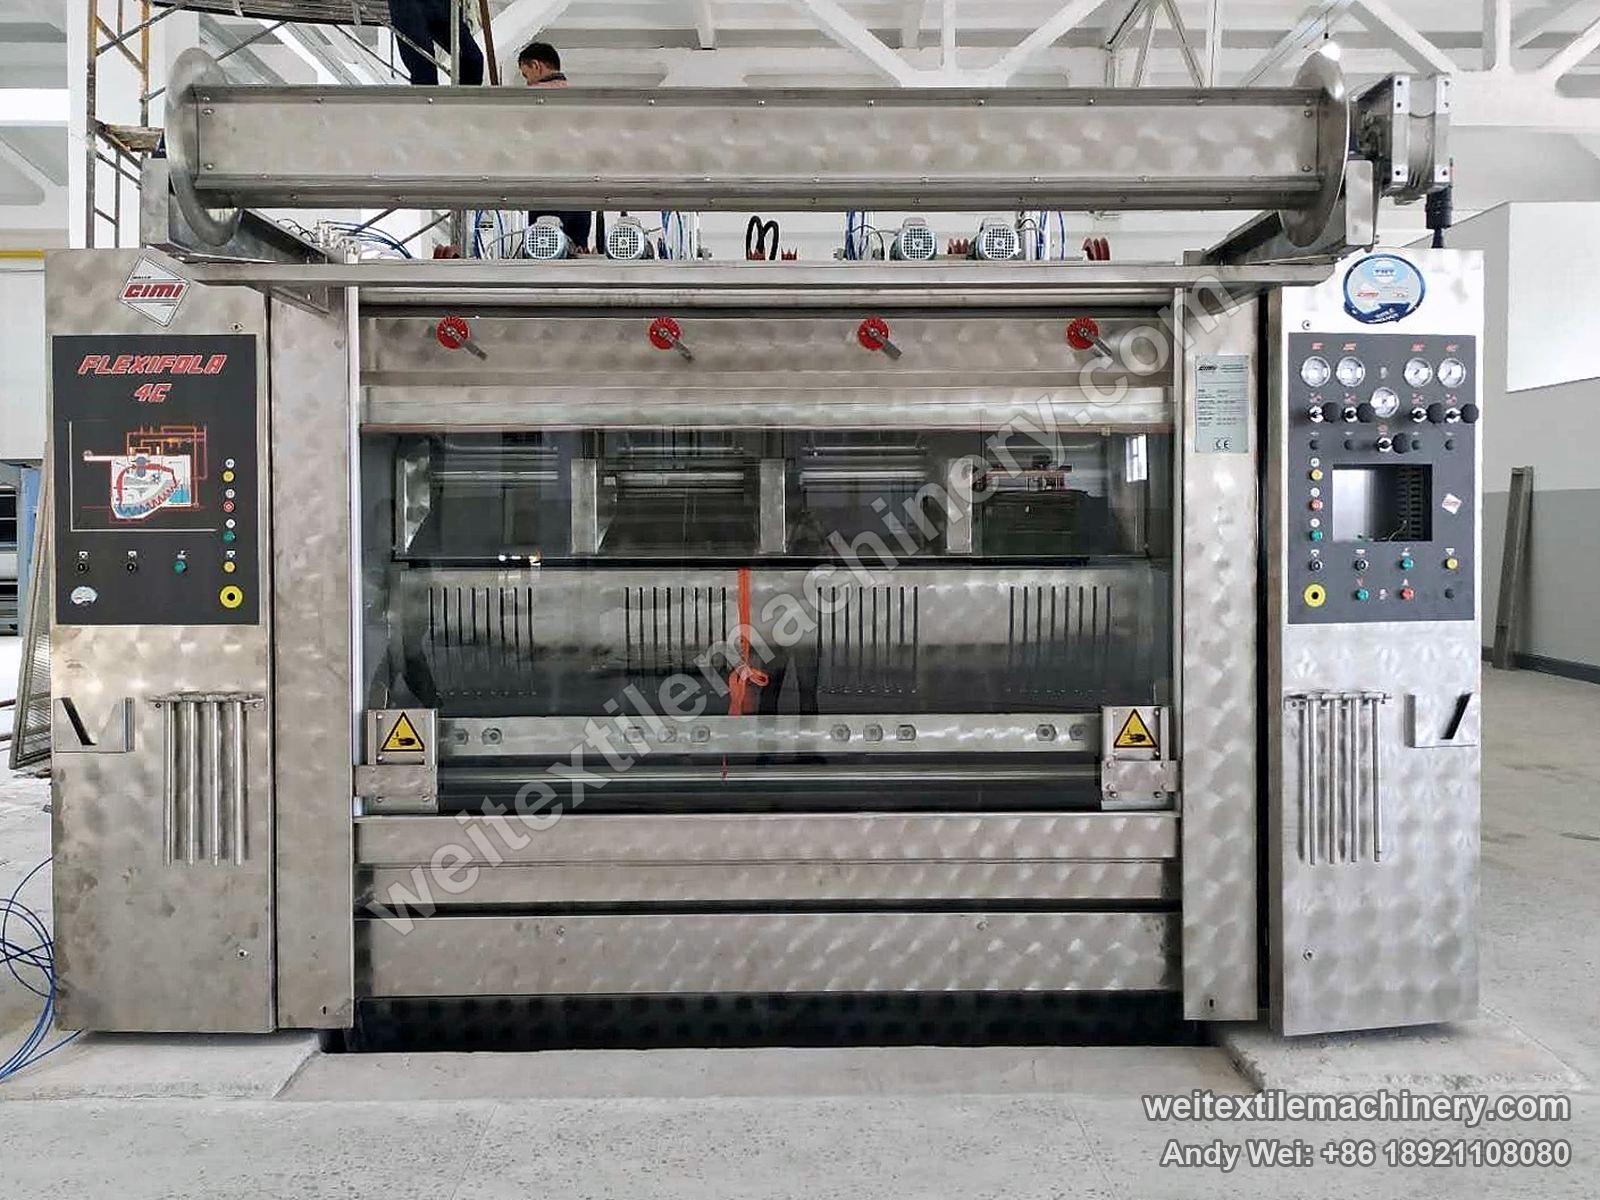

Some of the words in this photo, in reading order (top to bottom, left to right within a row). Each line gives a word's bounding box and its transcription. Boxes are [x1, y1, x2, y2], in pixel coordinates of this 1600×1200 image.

[124, 284, 184, 298] CIMI
[78, 355, 227, 375] FLEXIFOLA
[134, 383, 172, 402] 4C
